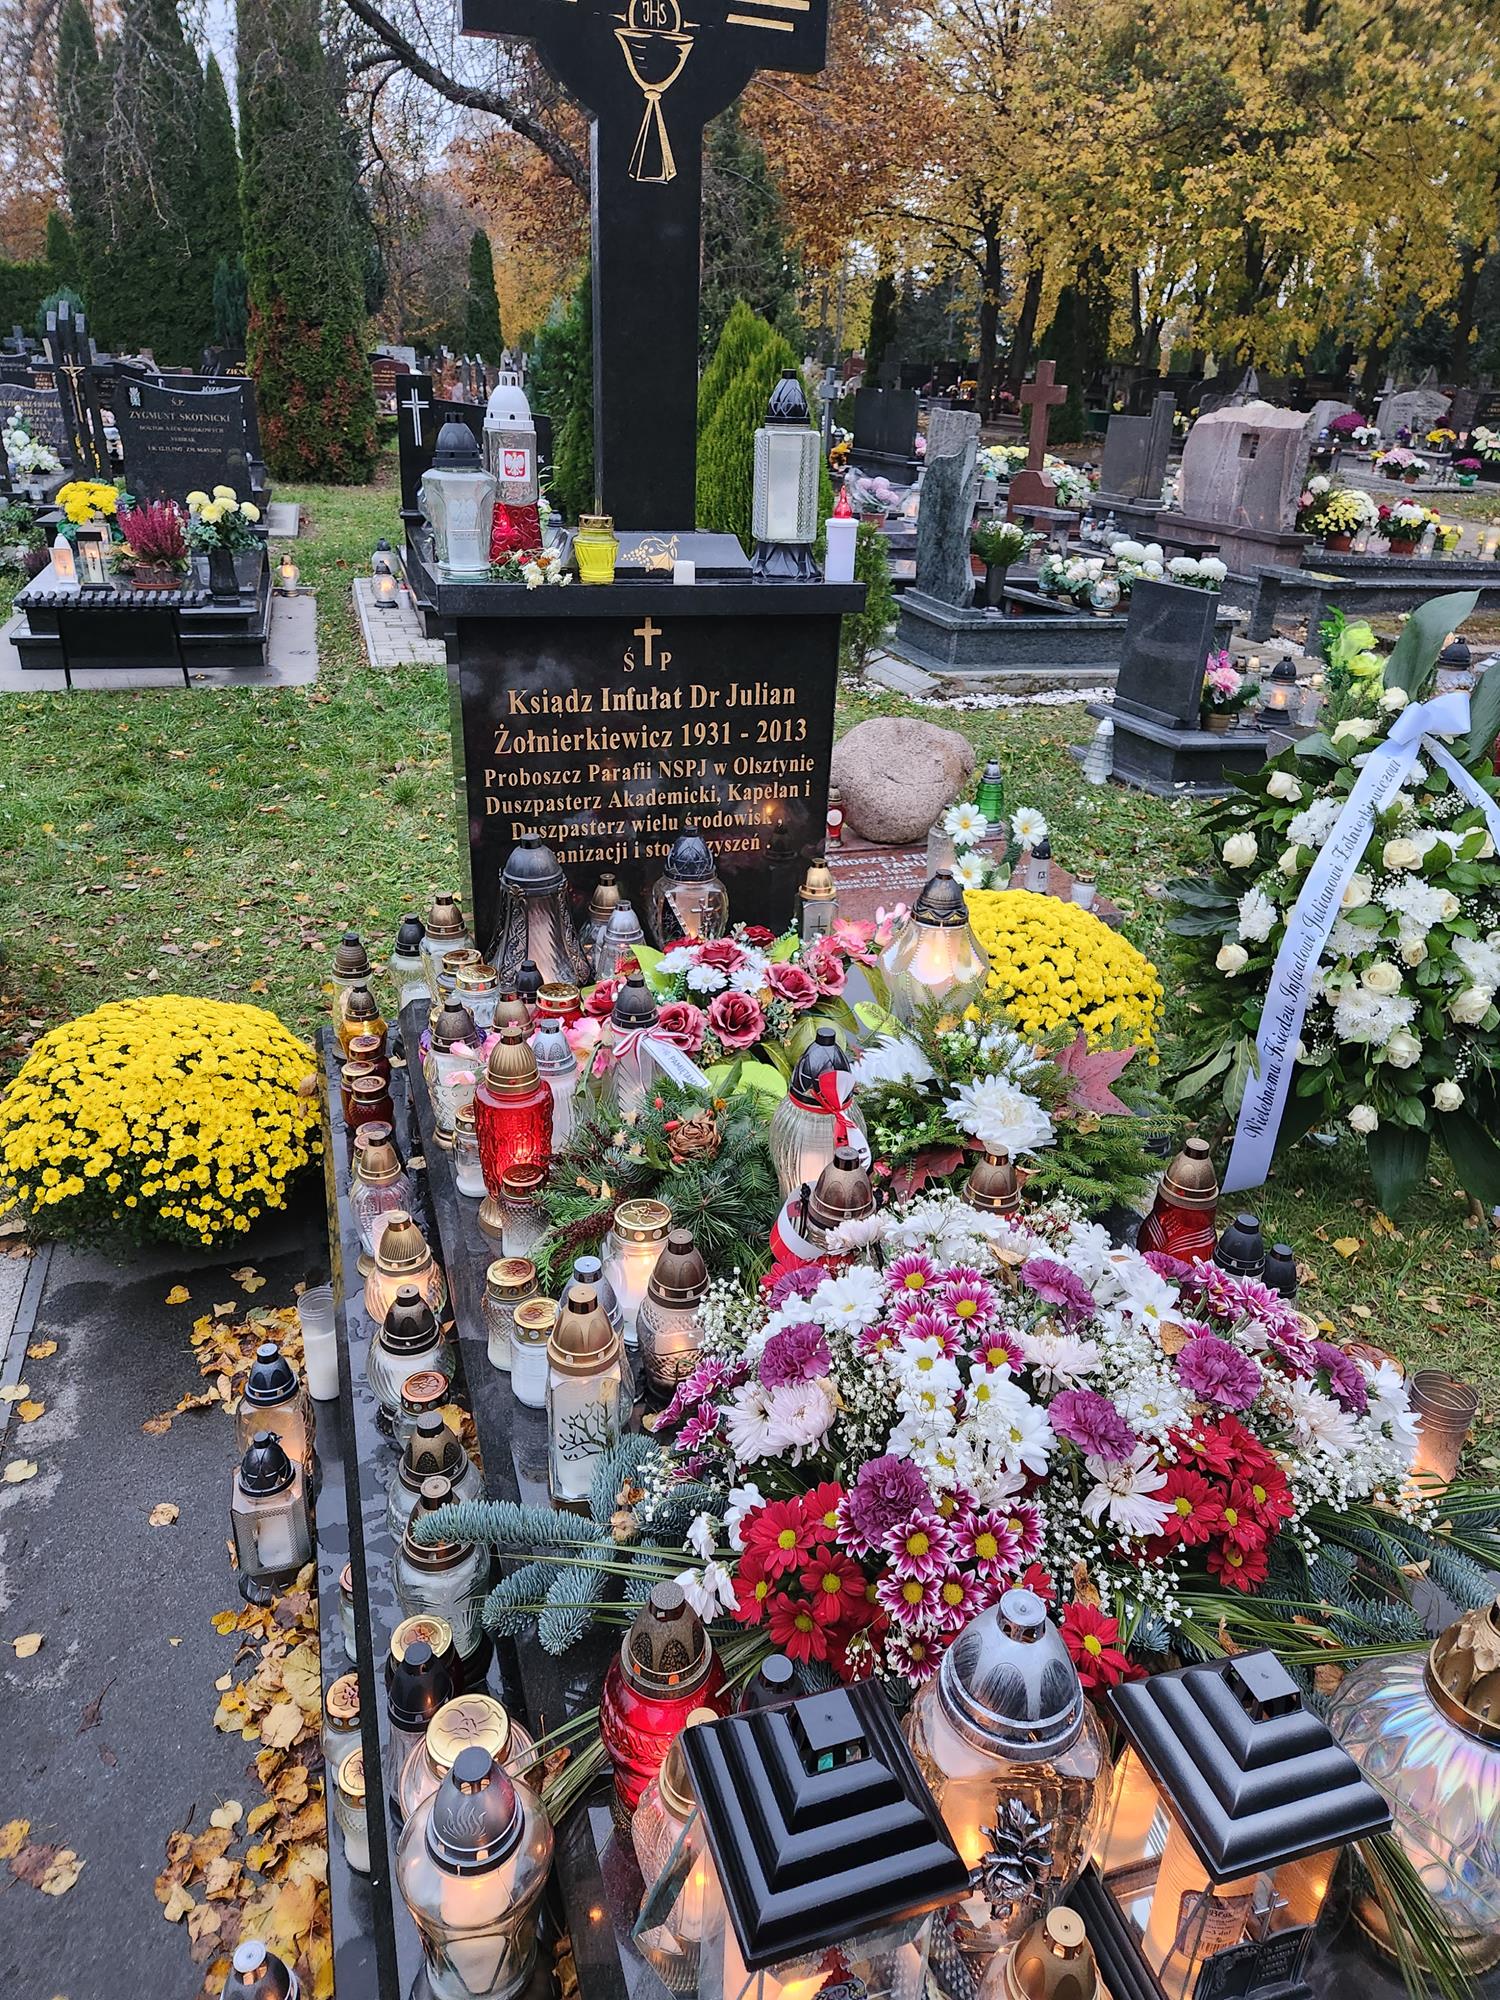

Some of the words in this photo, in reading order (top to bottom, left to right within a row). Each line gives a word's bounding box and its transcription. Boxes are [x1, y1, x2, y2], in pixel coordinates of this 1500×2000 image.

[129, 411, 175, 421] ZYGMUNT
[180, 413, 230, 423] SKOTNICKI
[659, 651, 673, 672] P
[507, 688, 593, 718] Ksiądz
[600, 685, 683, 712] Infułat
[689, 684, 720, 709] Dr
[725, 681, 796, 707] Julian
[493, 723, 673, 755] Żołnierkiewicz
[681, 721, 731, 746] 1931
[756, 718, 807, 743] 2013
[484, 767, 581, 788] Proboszcz
[588, 762, 651, 782] Parafii
[658, 758, 706, 779] NSPJ
[713, 762, 727, 775] w
[733, 753, 815, 779] Olsztynie
[485, 794, 602, 817] Duszpasterz
[608, 786, 722, 809] Akademicki,
[727, 782, 799, 804] Kapelan
[804, 780, 811, 797] i
[511, 818, 625, 842] Duszpasterz
[631, 812, 679, 834] wielu
[634, 840, 640, 857] i
[827, 855, 897, 868] ANDRZEJ
[1243, 1061, 1281, 1139] Wielebnemu
[1302, 862, 1344, 938] Julianowi
